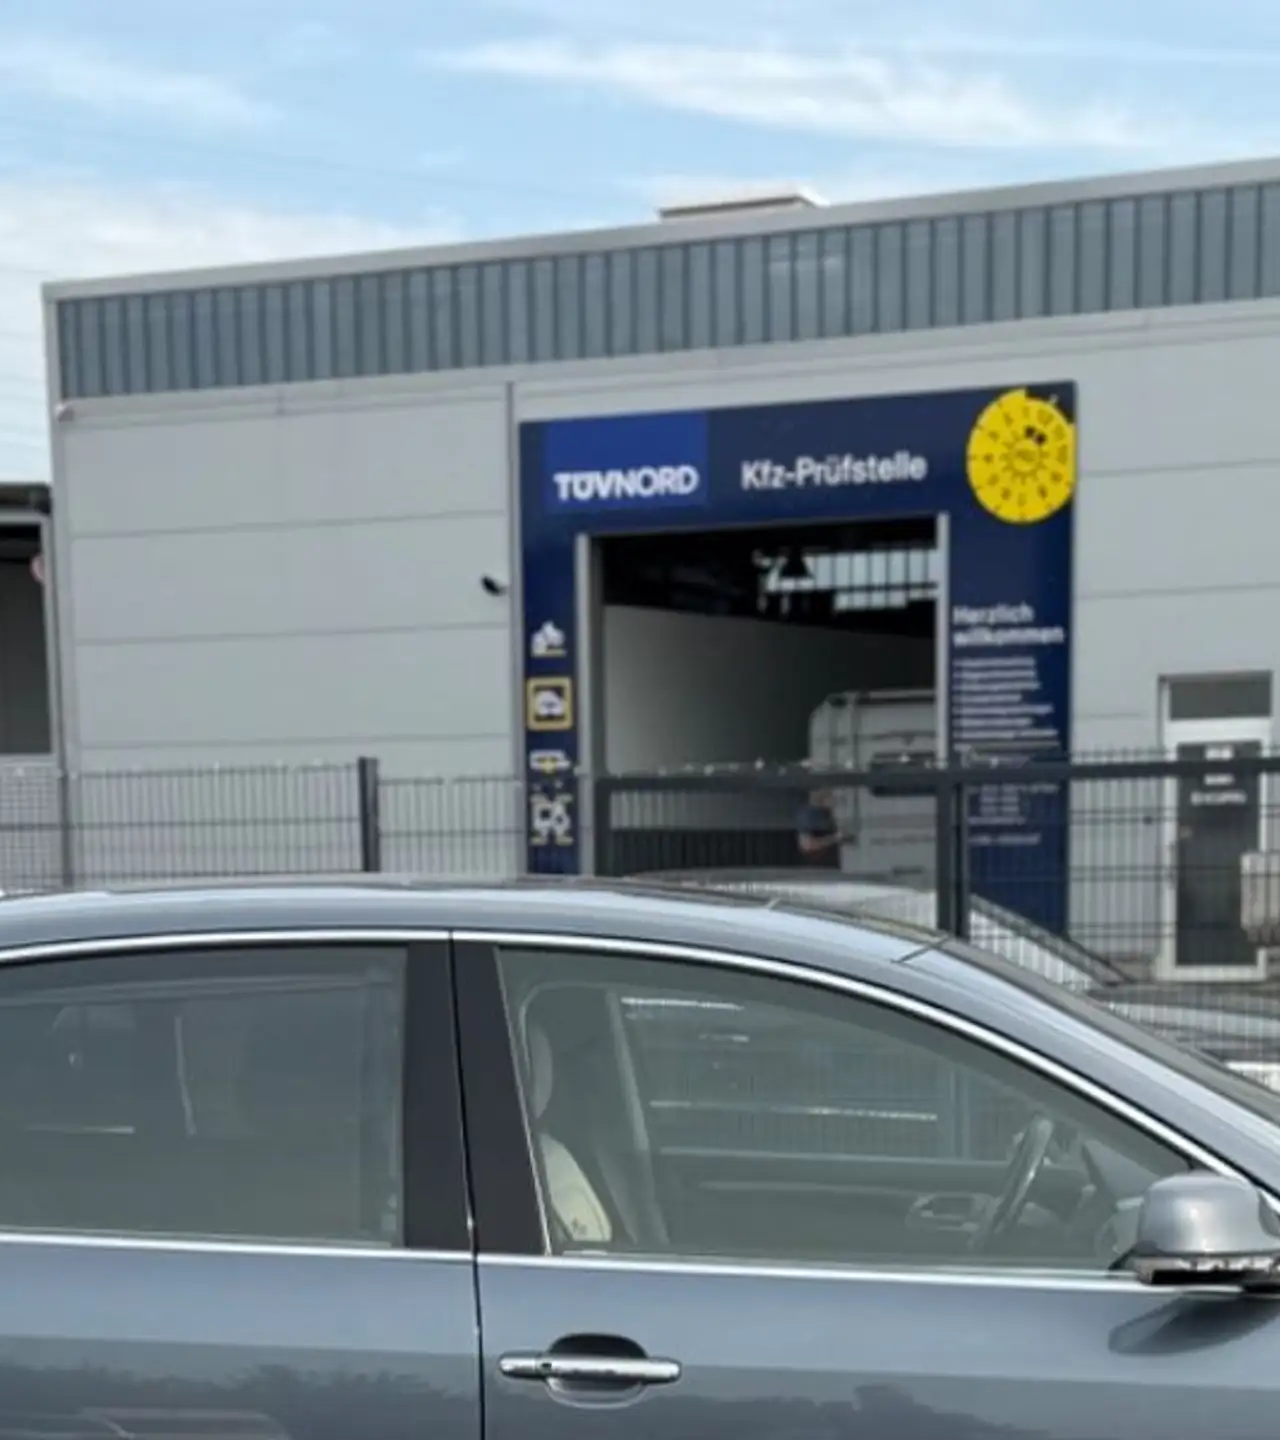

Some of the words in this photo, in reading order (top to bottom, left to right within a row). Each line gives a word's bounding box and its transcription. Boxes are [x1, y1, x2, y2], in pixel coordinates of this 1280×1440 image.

[740, 451, 928, 490] Kfz-Prüfstelle
[952, 602, 1035, 625] Herzlich
[952, 626, 1065, 648] willkommen
